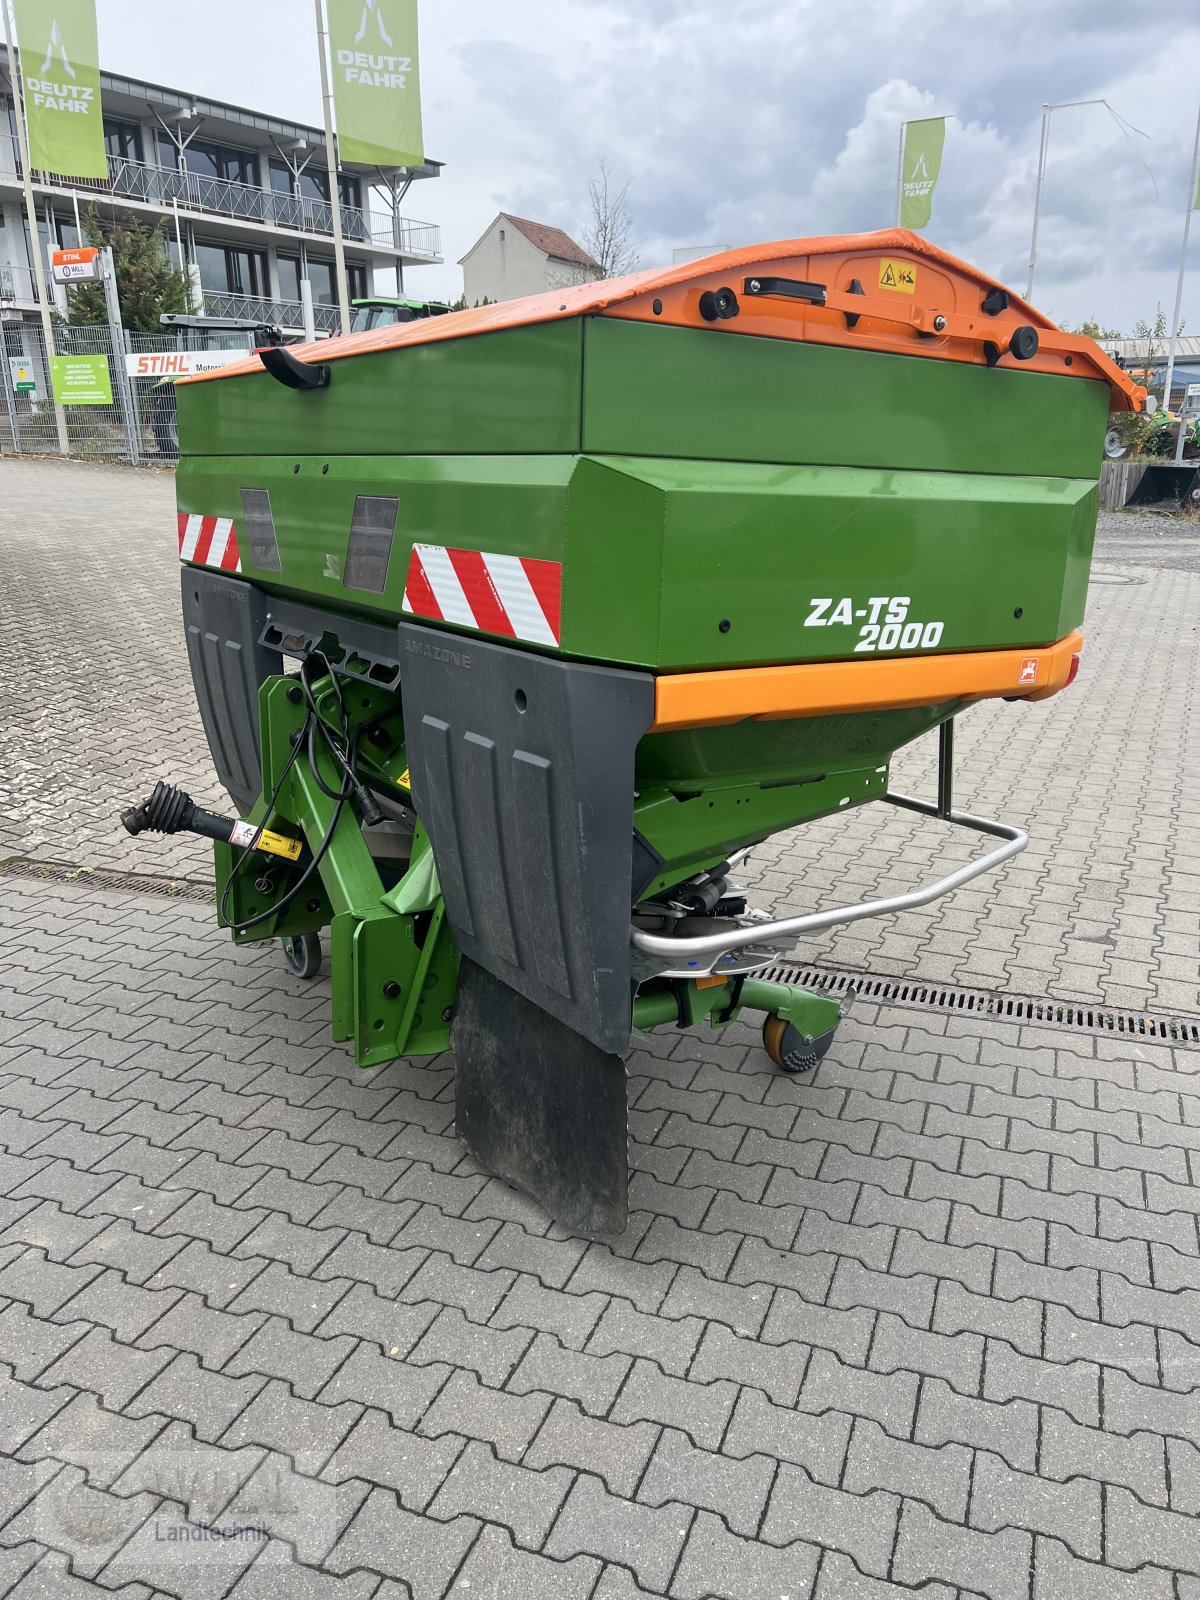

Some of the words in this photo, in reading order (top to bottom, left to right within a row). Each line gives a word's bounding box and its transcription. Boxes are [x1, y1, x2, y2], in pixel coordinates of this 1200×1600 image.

[337, 49, 412, 72] DEUTZ
[26, 76, 94, 100] DEUTZ
[345, 67, 406, 89] FAHR
[33, 92, 89, 115] FAHR
[903, 180, 934, 190] DEUTZ
[905, 188, 930, 197] FAHR
[62, 253, 82, 261] STIHL
[137, 356, 190, 373] STIHL
[803, 596, 911, 627] ZA-TS
[853, 621, 945, 652] 2000
[404, 639, 472, 671] AMAZONE
